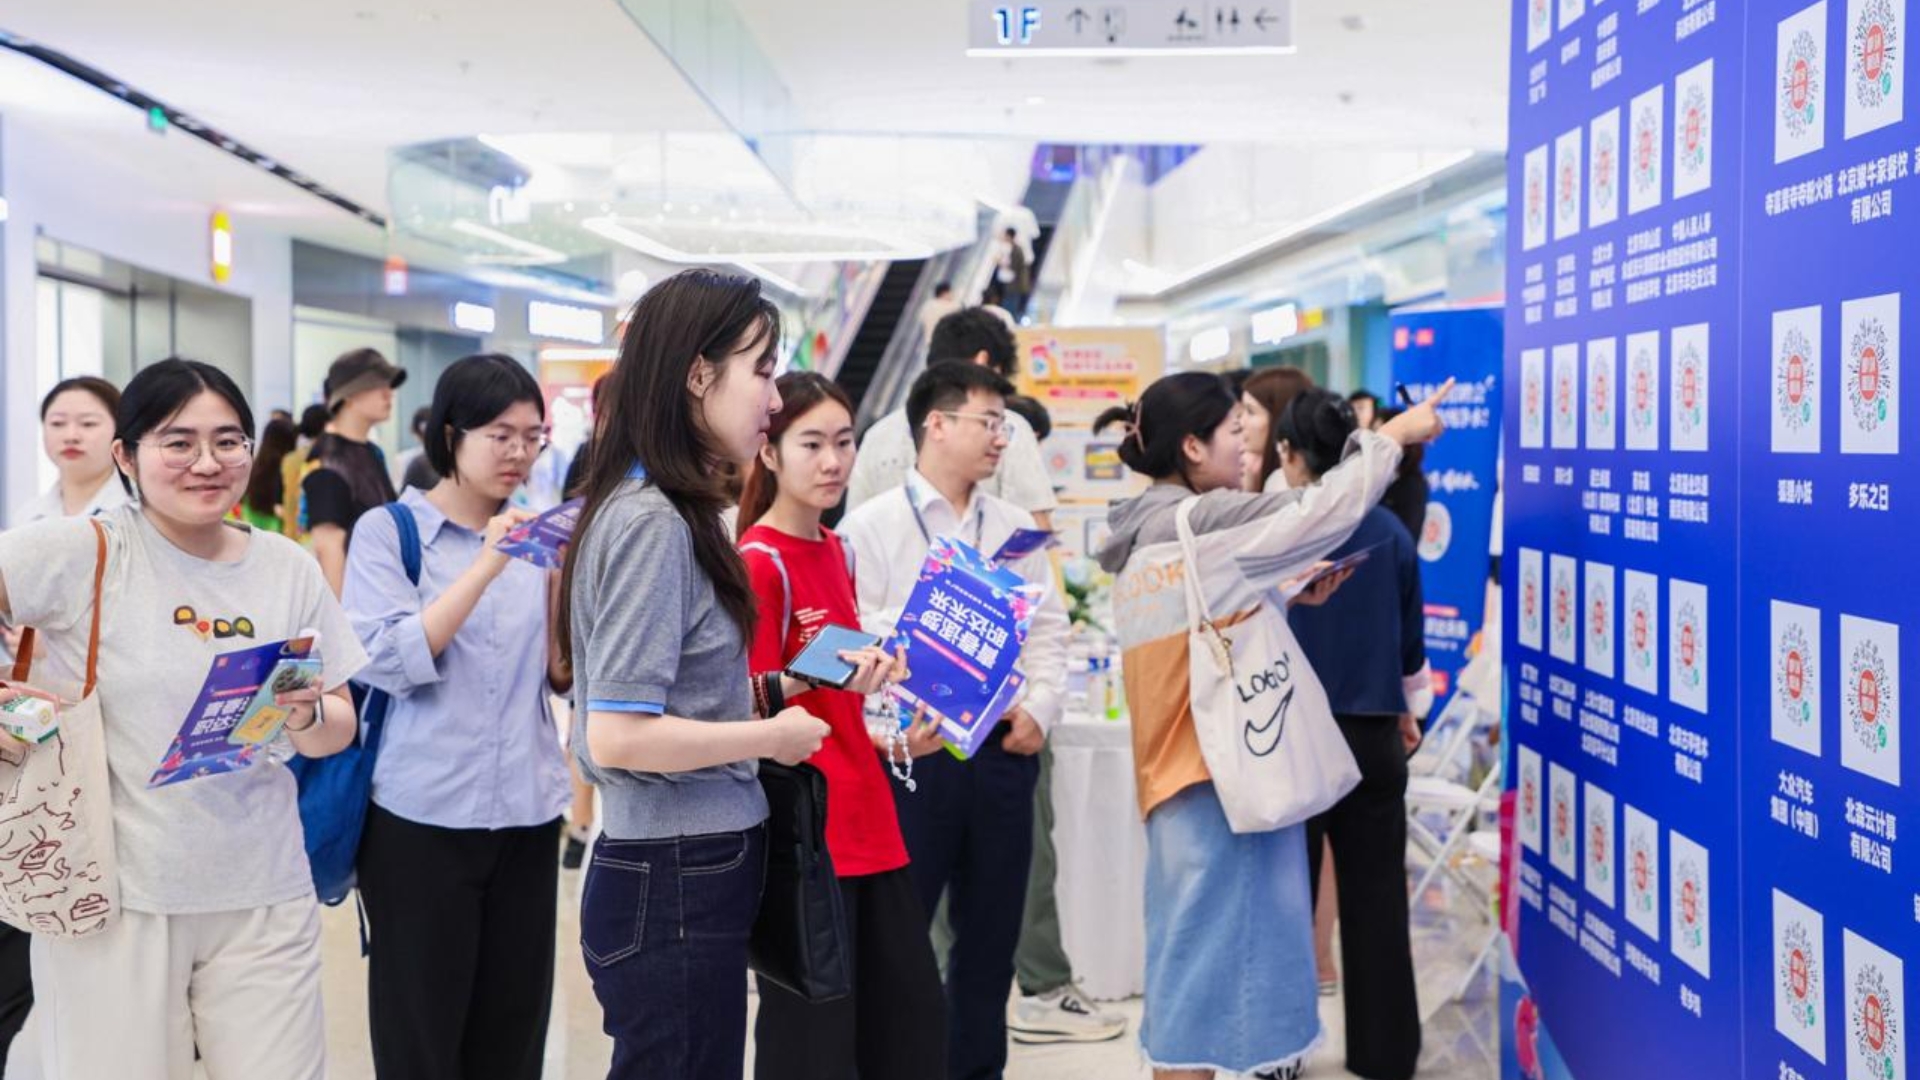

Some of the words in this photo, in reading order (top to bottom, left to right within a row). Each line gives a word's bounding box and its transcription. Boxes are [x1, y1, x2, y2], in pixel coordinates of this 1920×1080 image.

[993, 8, 1042, 45] 1F
[1850, 188, 1892, 225] 有限公司
[1849, 482, 1890, 511] 多乐之日
[928, 586, 1009, 649] 职达未来
[920, 610, 999, 669] 青春逐梦
[1778, 770, 1814, 806] 大众汽车
[1845, 797, 1897, 842] 北森云计算
[1850, 831, 1892, 874] 有限公司
